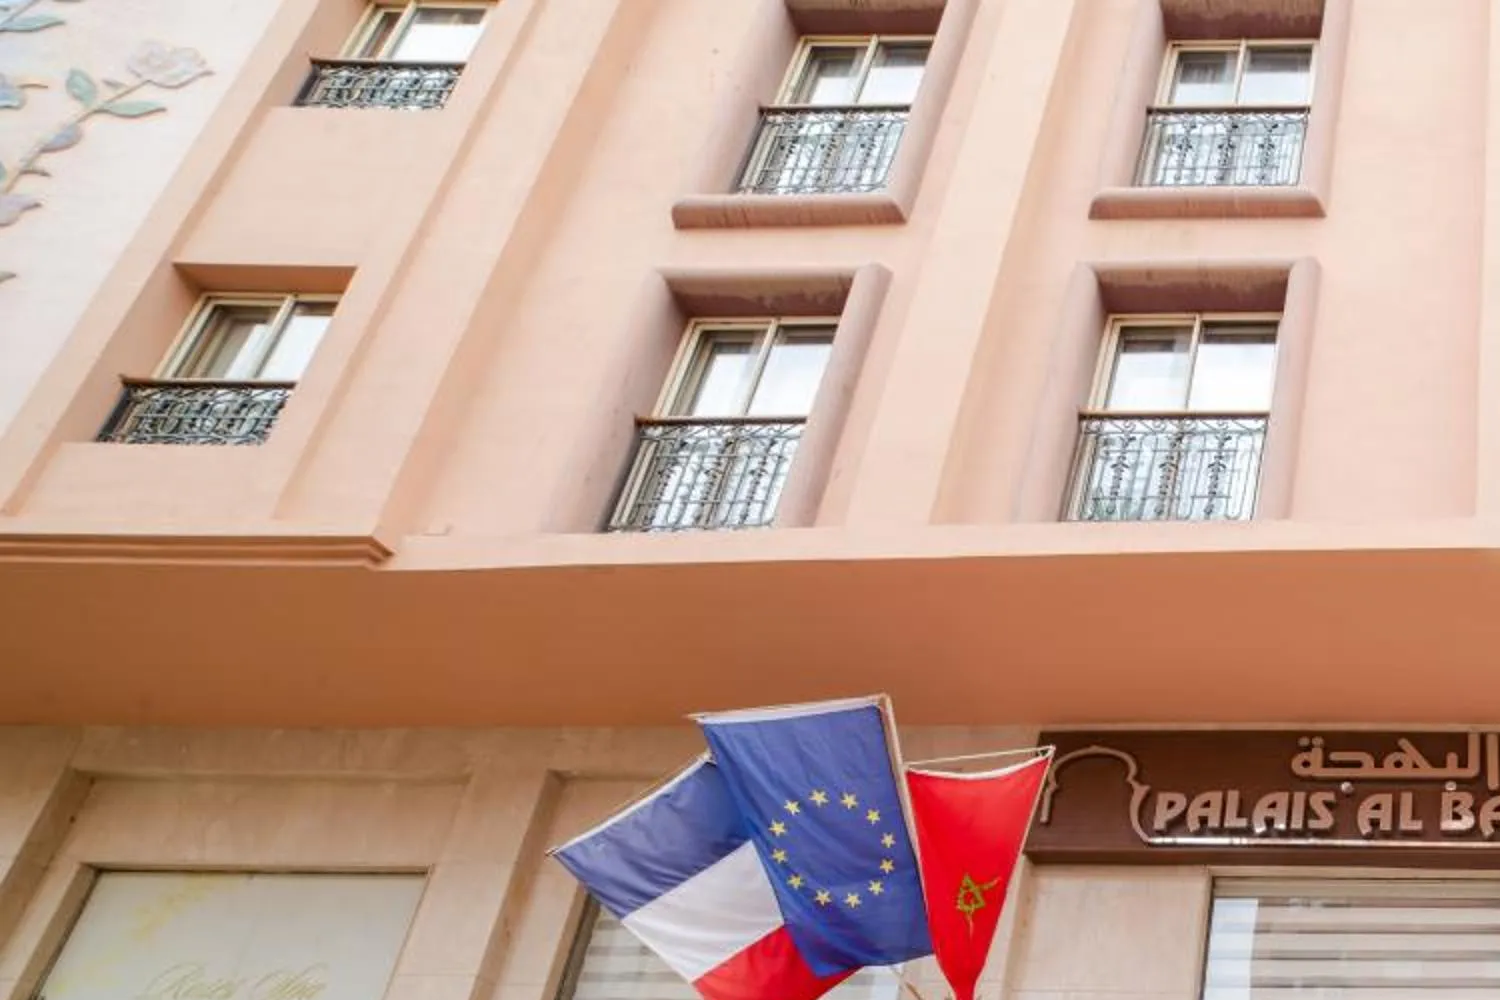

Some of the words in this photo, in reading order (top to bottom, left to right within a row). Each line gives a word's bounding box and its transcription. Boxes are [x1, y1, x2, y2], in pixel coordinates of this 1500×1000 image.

[1292, 731, 1500, 794] البهجة
[1153, 790, 1337, 834] PALAIS
[1356, 792, 1424, 836] AL
